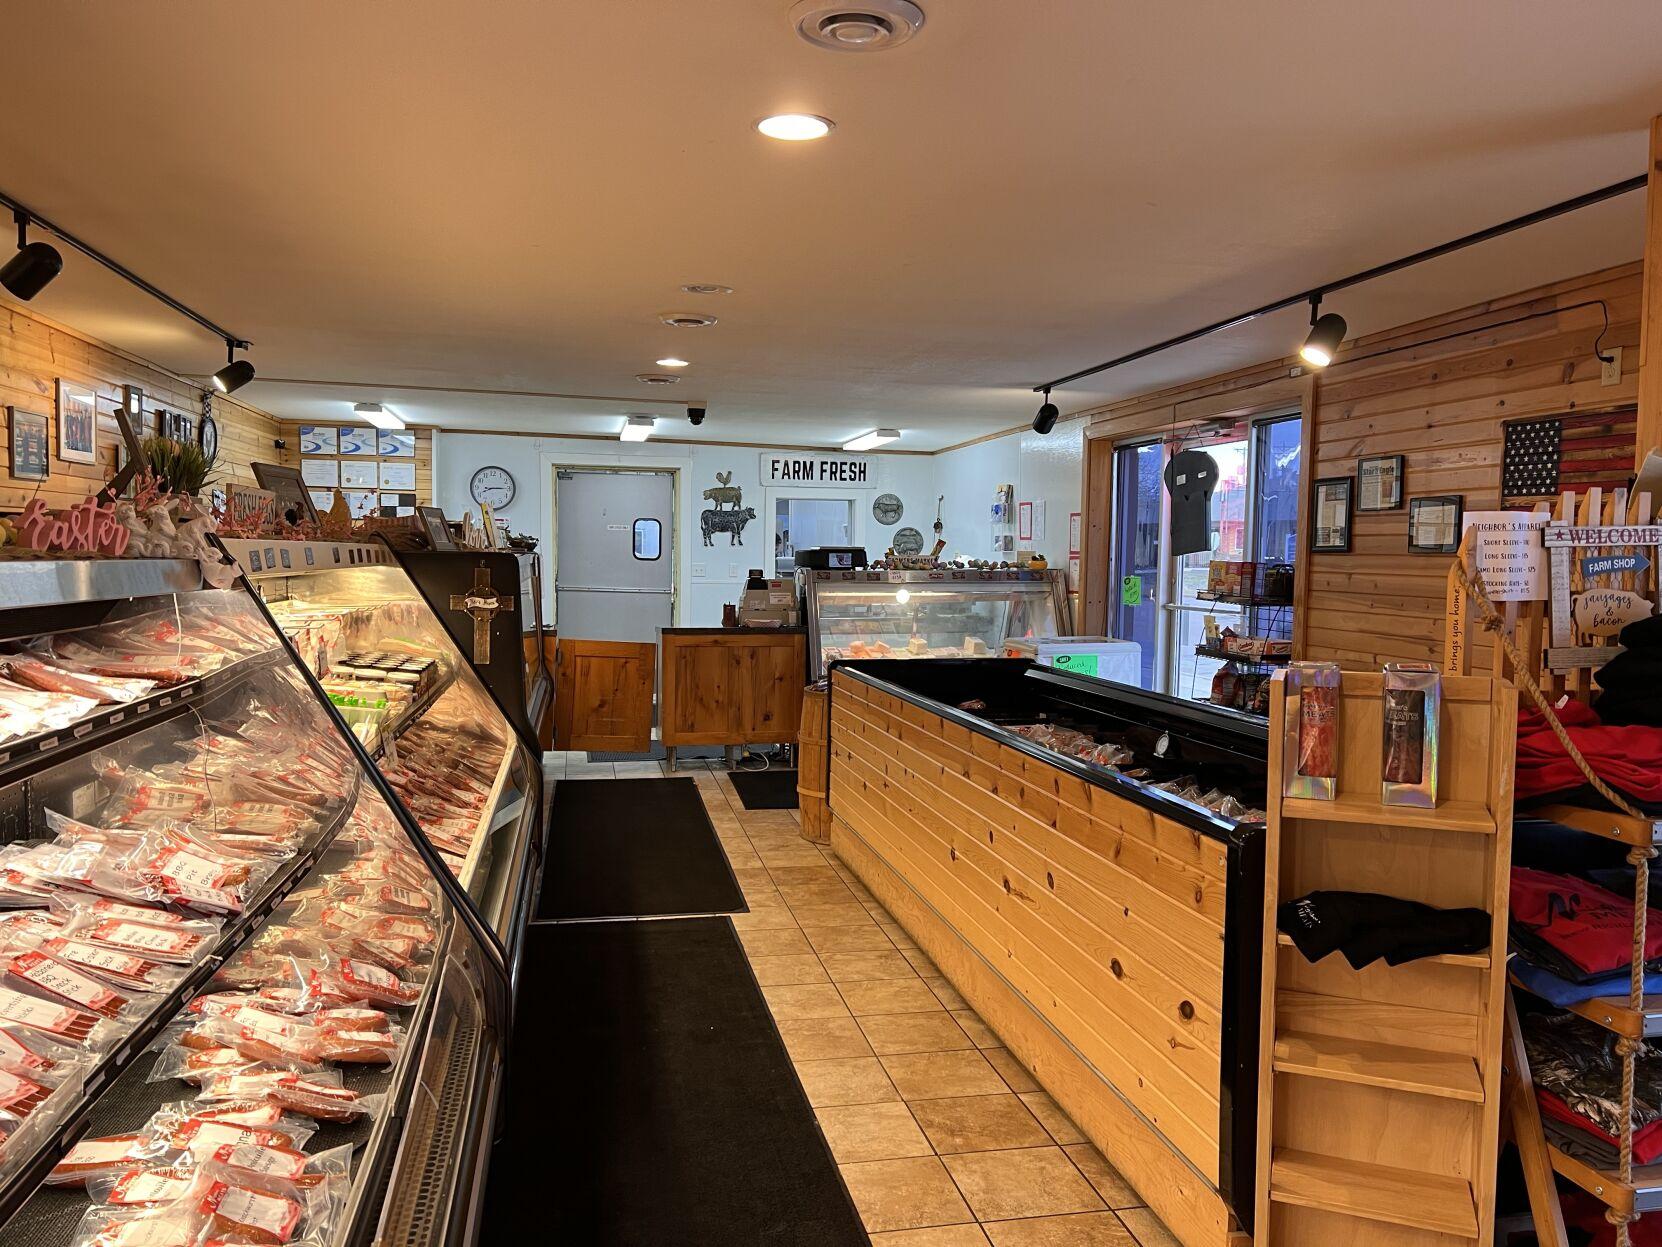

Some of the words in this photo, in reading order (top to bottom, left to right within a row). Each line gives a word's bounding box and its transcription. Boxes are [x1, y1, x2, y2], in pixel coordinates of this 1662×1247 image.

[771, 459, 814, 480] FARM
[820, 461, 867, 482] FRESH
[23, 497, 130, 556] Easter
[1569, 528, 1659, 544] WELCOME
[1589, 560, 1612, 573] FARM
[1613, 558, 1635, 569] SHOP
[1584, 593, 1633, 610] sausages
[1606, 607, 1614, 616] &
[1453, 619, 1462, 637] you
[1593, 614, 1625, 627] bacon
[1448, 641, 1462, 671] brings
[187, 869, 198, 881] Pit
